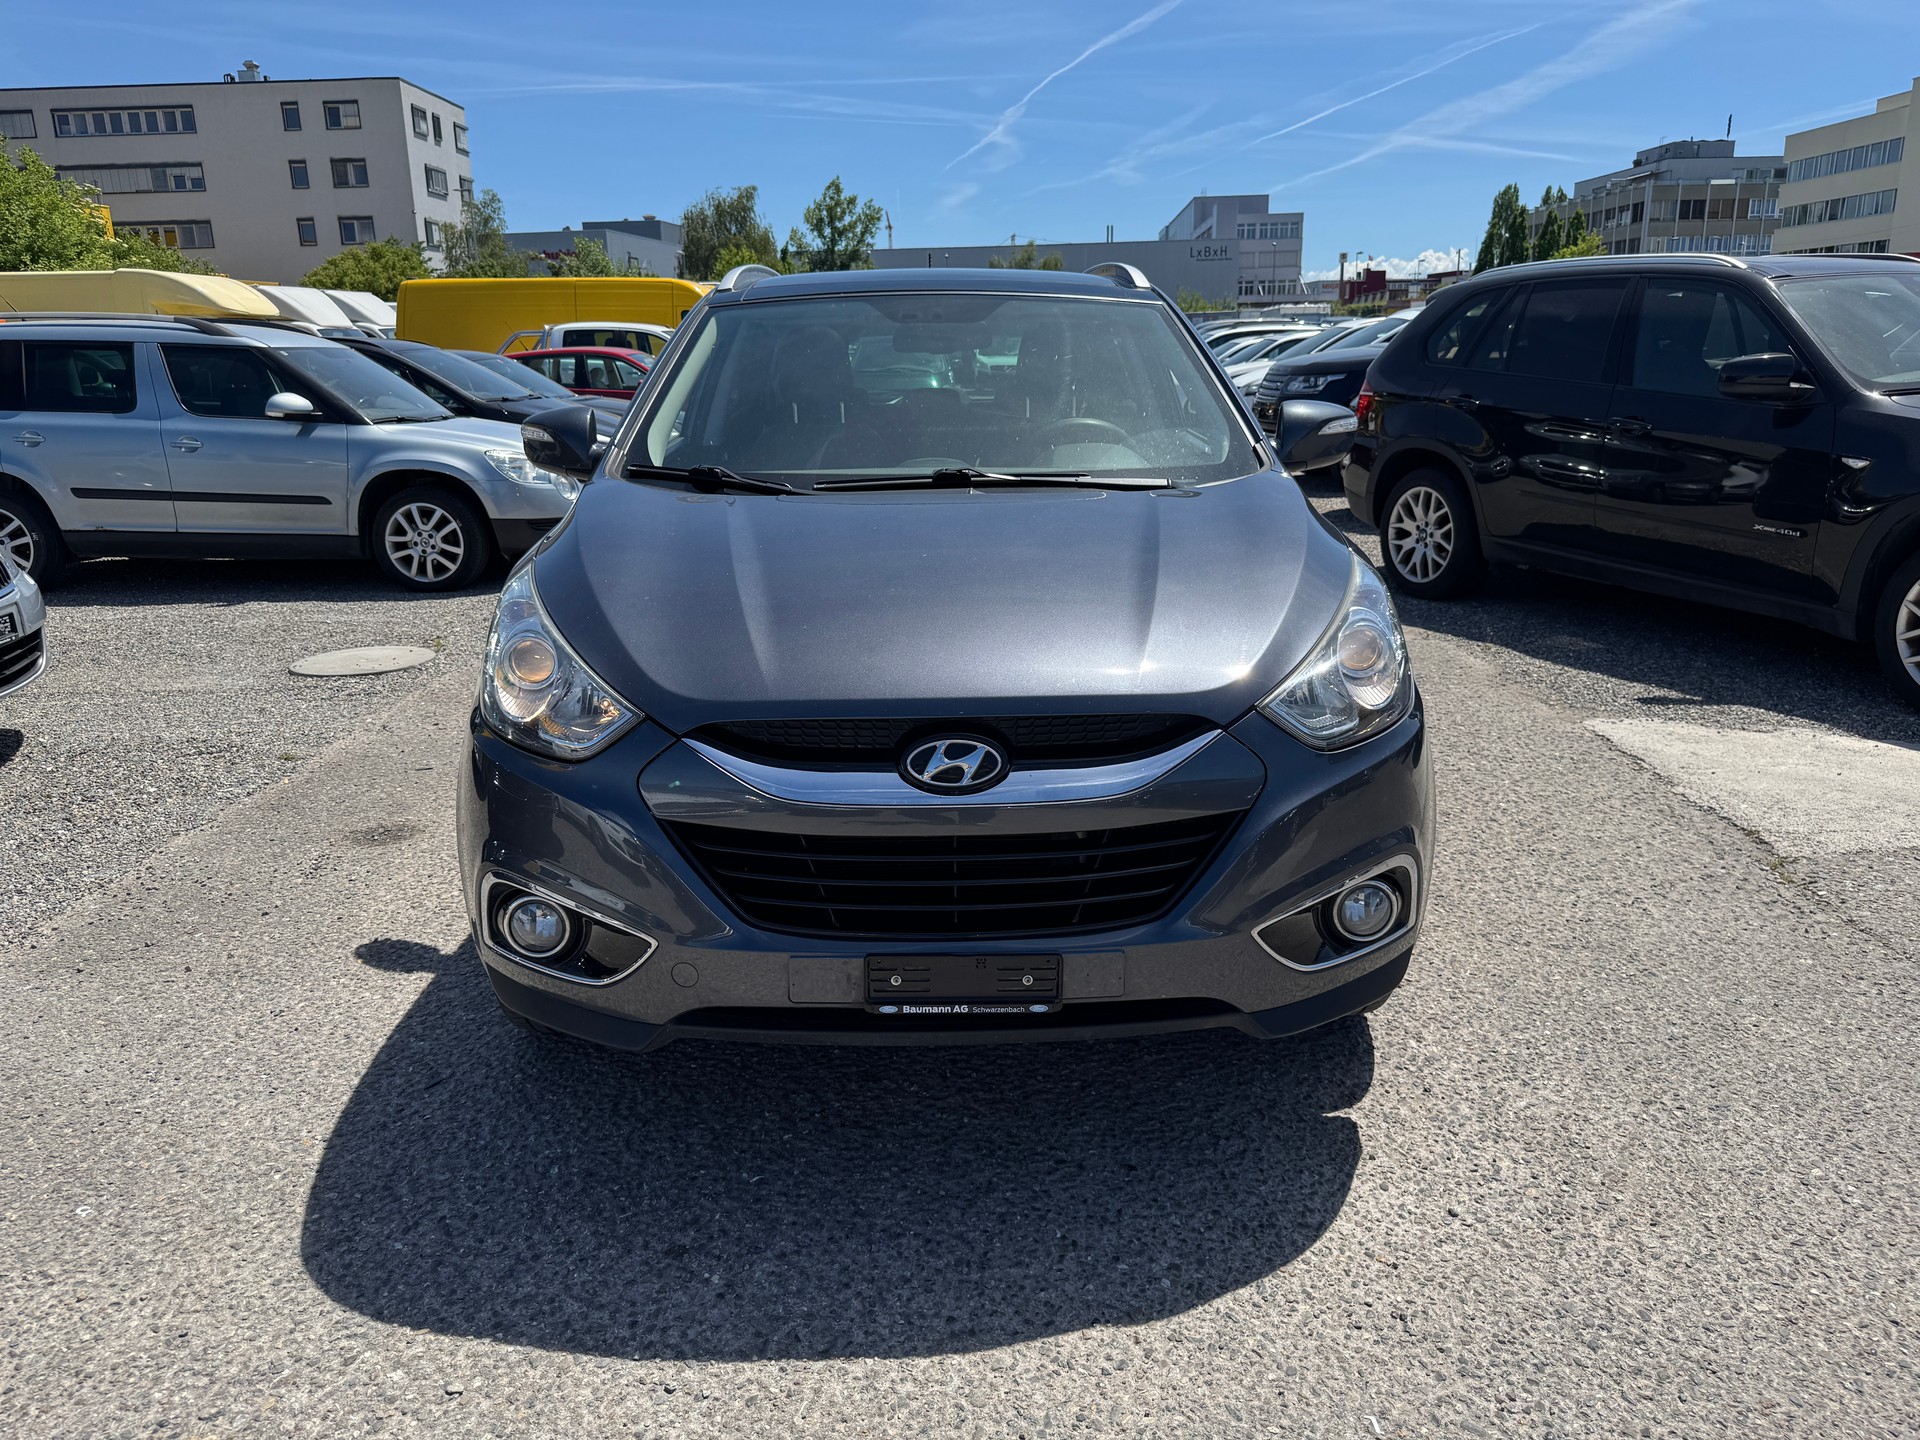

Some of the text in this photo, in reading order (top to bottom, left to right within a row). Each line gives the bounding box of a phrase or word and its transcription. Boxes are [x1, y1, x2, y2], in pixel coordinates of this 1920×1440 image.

[1190, 246, 1227, 258] LxBxH
[903, 1005, 951, 1014] Baumann
[953, 1005, 969, 1013] AG
